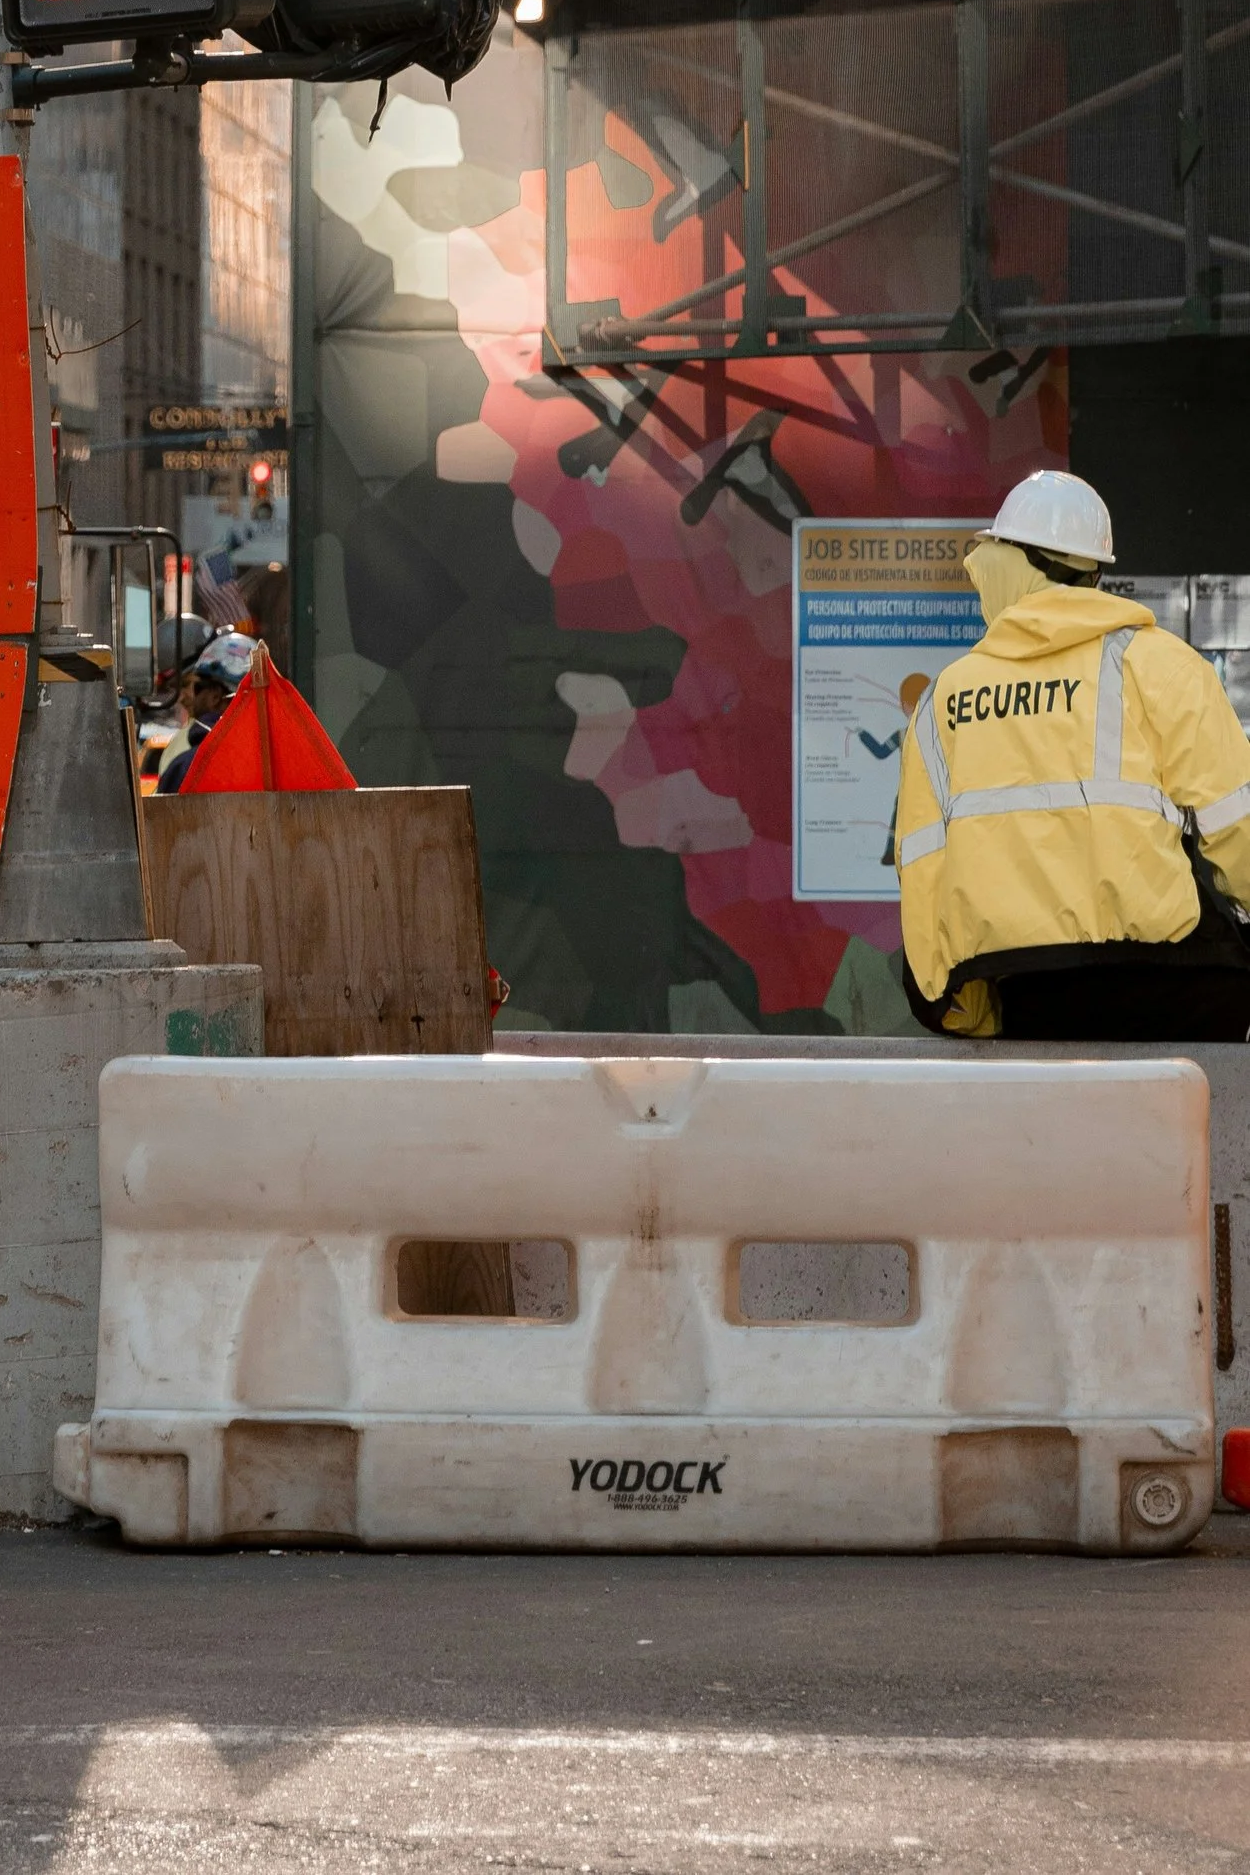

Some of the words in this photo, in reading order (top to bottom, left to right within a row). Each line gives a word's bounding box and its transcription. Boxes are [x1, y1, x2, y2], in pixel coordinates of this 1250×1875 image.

[805, 538, 842, 561] JOB
[849, 539, 889, 561] SITE
[895, 539, 958, 561] DRESS
[853, 568, 908, 582] VESTIMENTA
[807, 600, 855, 616] PERSONAL
[857, 600, 913, 616] PROTECTIVE
[915, 600, 970, 617] EQUIPMENT
[808, 625, 839, 640] EQUIPO
[841, 625, 852, 639] DE
[906, 625, 948, 640] PERSONAL
[950, 625, 960, 639] ES
[947, 678, 1081, 731] SECURITY
[569, 1458, 727, 1494] YODOCK
[607, 1493, 688, 1504] 1-888-496-3625
[613, 1502, 680, 1511] WWW.YODOCK.COM
